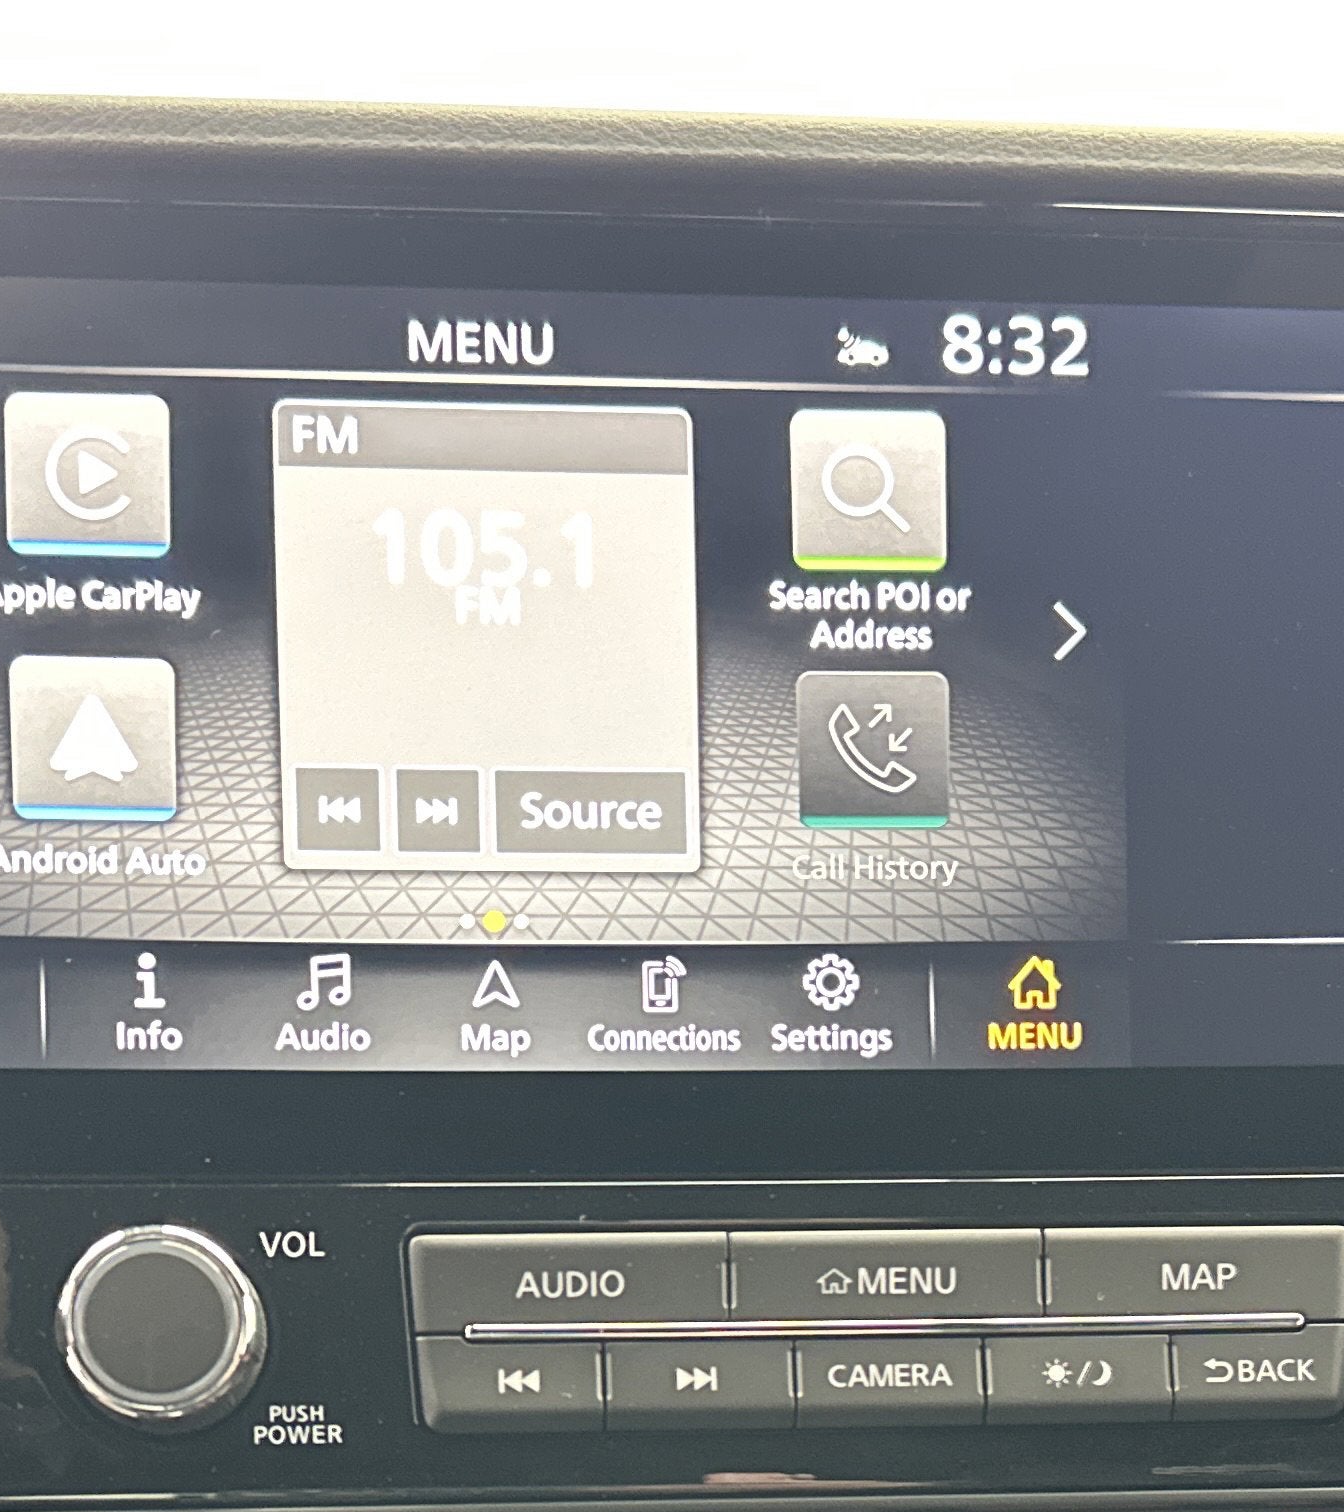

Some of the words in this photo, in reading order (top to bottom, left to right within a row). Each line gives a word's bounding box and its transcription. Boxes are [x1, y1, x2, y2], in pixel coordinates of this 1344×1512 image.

[408, 320, 554, 366] MENU
[940, 314, 1091, 379] 8:32
[293, 415, 359, 455] FM
[372, 508, 596, 588] 105.1
[82, 577, 202, 620] CarPlay
[456, 586, 523, 626] FM
[768, 580, 871, 613] Search
[877, 582, 931, 613] POI
[937, 589, 971, 613] or
[809, 618, 934, 651] Address
[520, 791, 664, 831] Source
[126, 846, 206, 877] Auto
[792, 853, 843, 882] Call
[852, 854, 959, 888] History
[116, 1023, 184, 1053] Info
[275, 1022, 371, 1054] Audio
[461, 1024, 532, 1058] Map
[587, 1023, 741, 1054] Connections
[770, 1021, 893, 1058] Settings
[987, 1020, 1084, 1052] MENU
[259, 1231, 326, 1258] VOL
[515, 1271, 625, 1299] AUDIO
[857, 1267, 958, 1295] MENU
[1161, 1263, 1238, 1292] MAP
[827, 1363, 954, 1388] CAMERA
[1236, 1357, 1316, 1383] BACK
[268, 1405, 325, 1424] PUSH
[253, 1424, 344, 1446] POWER
